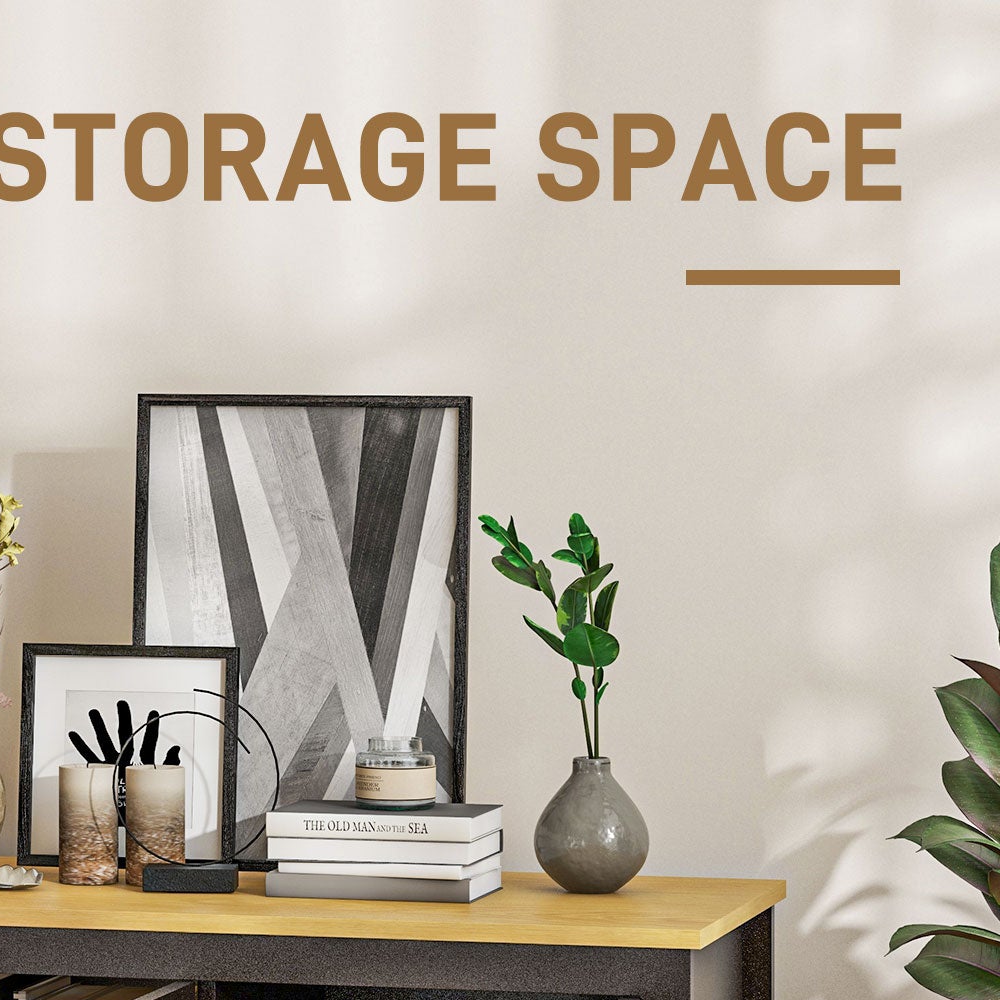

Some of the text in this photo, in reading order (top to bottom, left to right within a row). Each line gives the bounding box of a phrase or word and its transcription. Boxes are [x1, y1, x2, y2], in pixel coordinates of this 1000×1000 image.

[303, 819, 326, 831] THE
[327, 820, 350, 832] OLD
[352, 821, 376, 833] MAN
[408, 822, 429, 835] SEA
